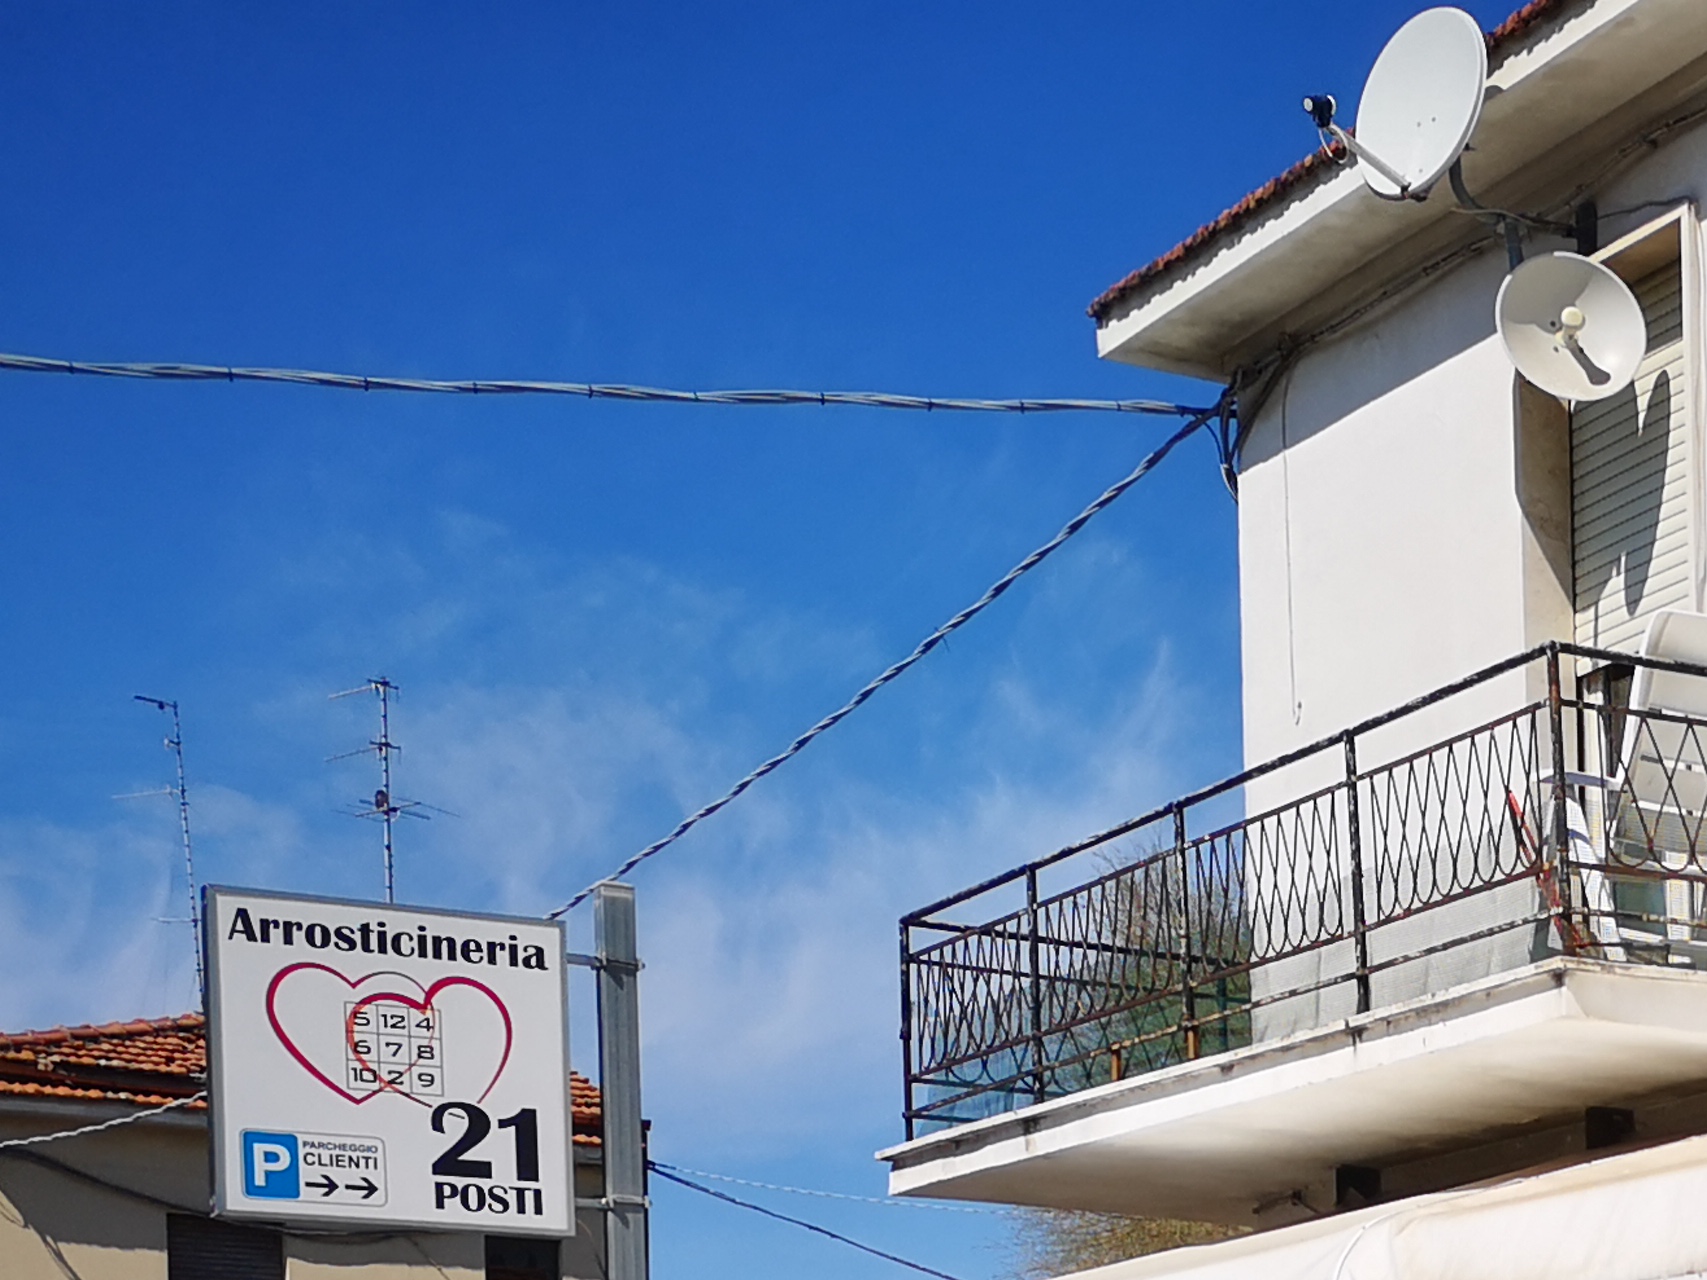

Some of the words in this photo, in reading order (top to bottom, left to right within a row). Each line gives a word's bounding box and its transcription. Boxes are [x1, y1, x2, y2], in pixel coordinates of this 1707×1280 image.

[228, 907, 549, 971] Arrosticineria
[353, 1012, 370, 1027] 5
[381, 1014, 407, 1030] 12
[415, 1017, 433, 1032] 4
[353, 1040, 372, 1055] 6
[386, 1042, 403, 1058] 7
[417, 1045, 435, 1060] 8
[351, 1067, 377, 1083] 10
[387, 1070, 405, 1085] 2
[417, 1072, 436, 1088] 9
[302, 1140, 378, 1154] PARCHEGGIO
[431, 1101, 540, 1183] 21
[252, 1143, 291, 1187] P
[303, 1153, 378, 1171] CLIENTI
[434, 1182, 544, 1216] POSTI
